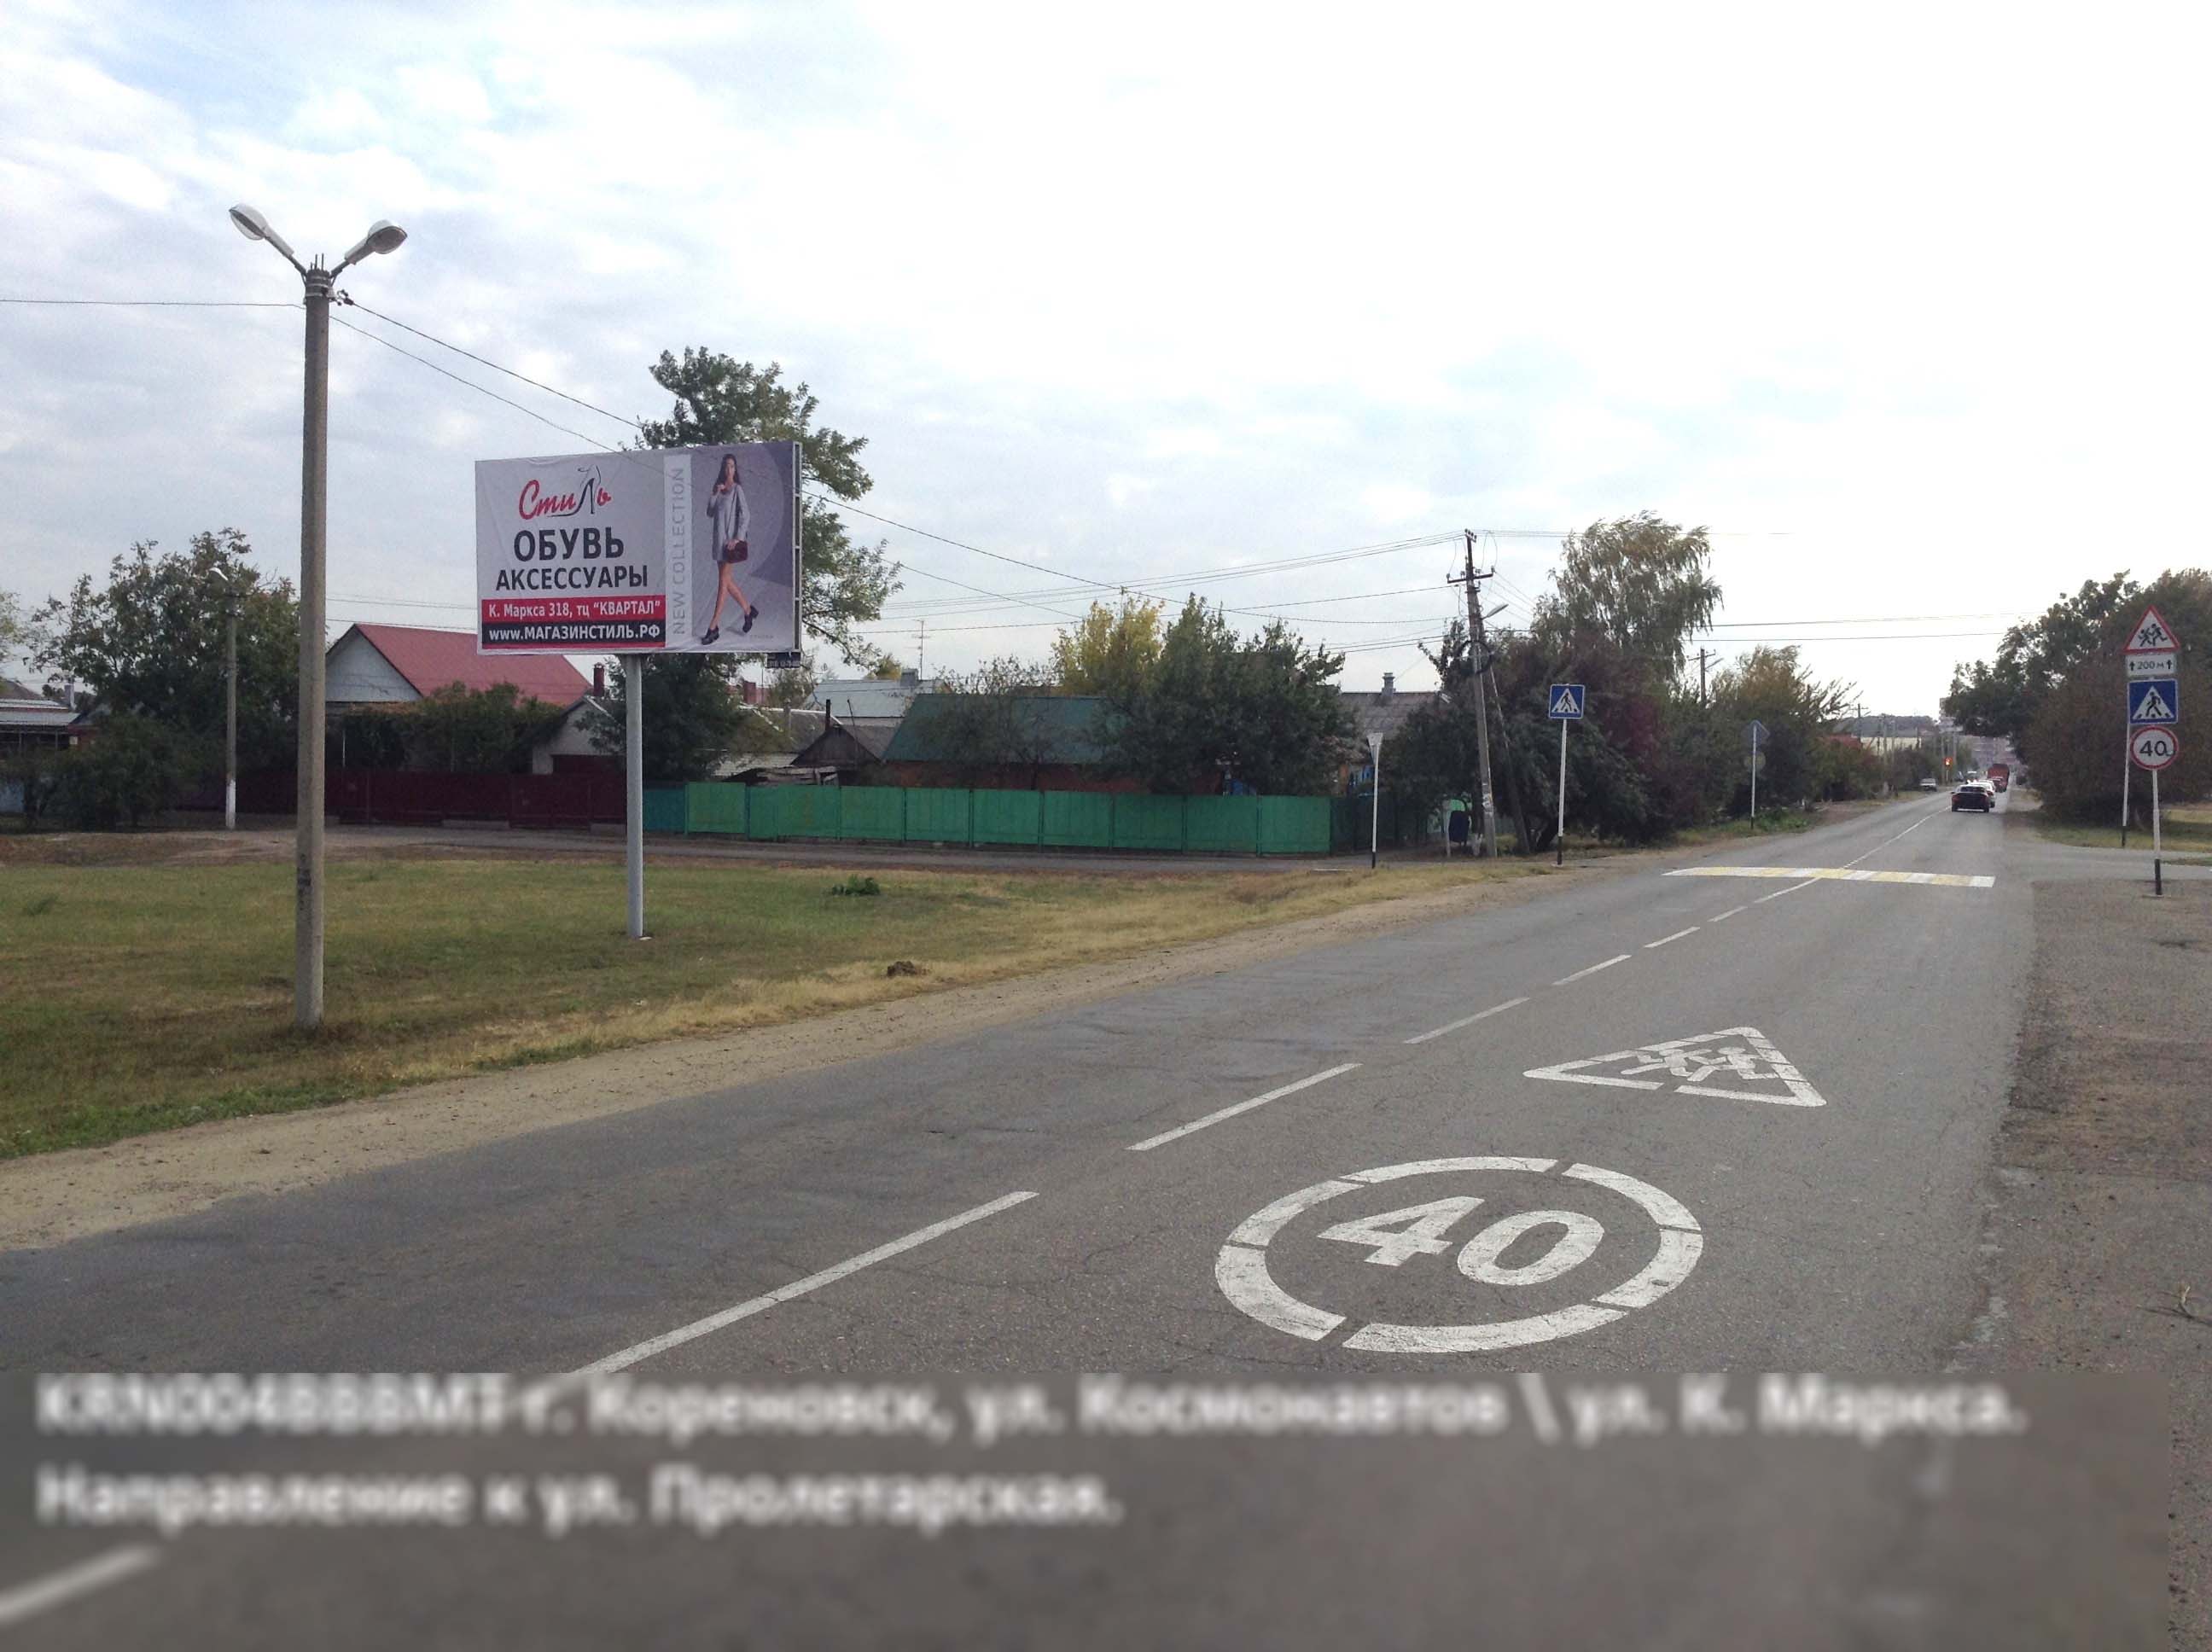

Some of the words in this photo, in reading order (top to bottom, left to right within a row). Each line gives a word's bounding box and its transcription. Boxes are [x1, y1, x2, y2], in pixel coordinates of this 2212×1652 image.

[672, 468, 685, 585] COLLECTION
[514, 526, 625, 562] ОБУВЬ
[496, 565, 648, 591] АКСЕССУАРЫ
[489, 604, 501, 618] К.
[504, 603, 546, 620] Маркса
[549, 602, 573, 619] 318,
[576, 603, 591, 619] тц
[672, 592, 686, 635] NEW
[489, 624, 661, 641] www.МАГАЗИНСТИЛЬ.РФ
[2137, 660, 2156, 670] 200
[2139, 740, 2168, 757] 40
[1316, 1195, 1605, 1286] 40
